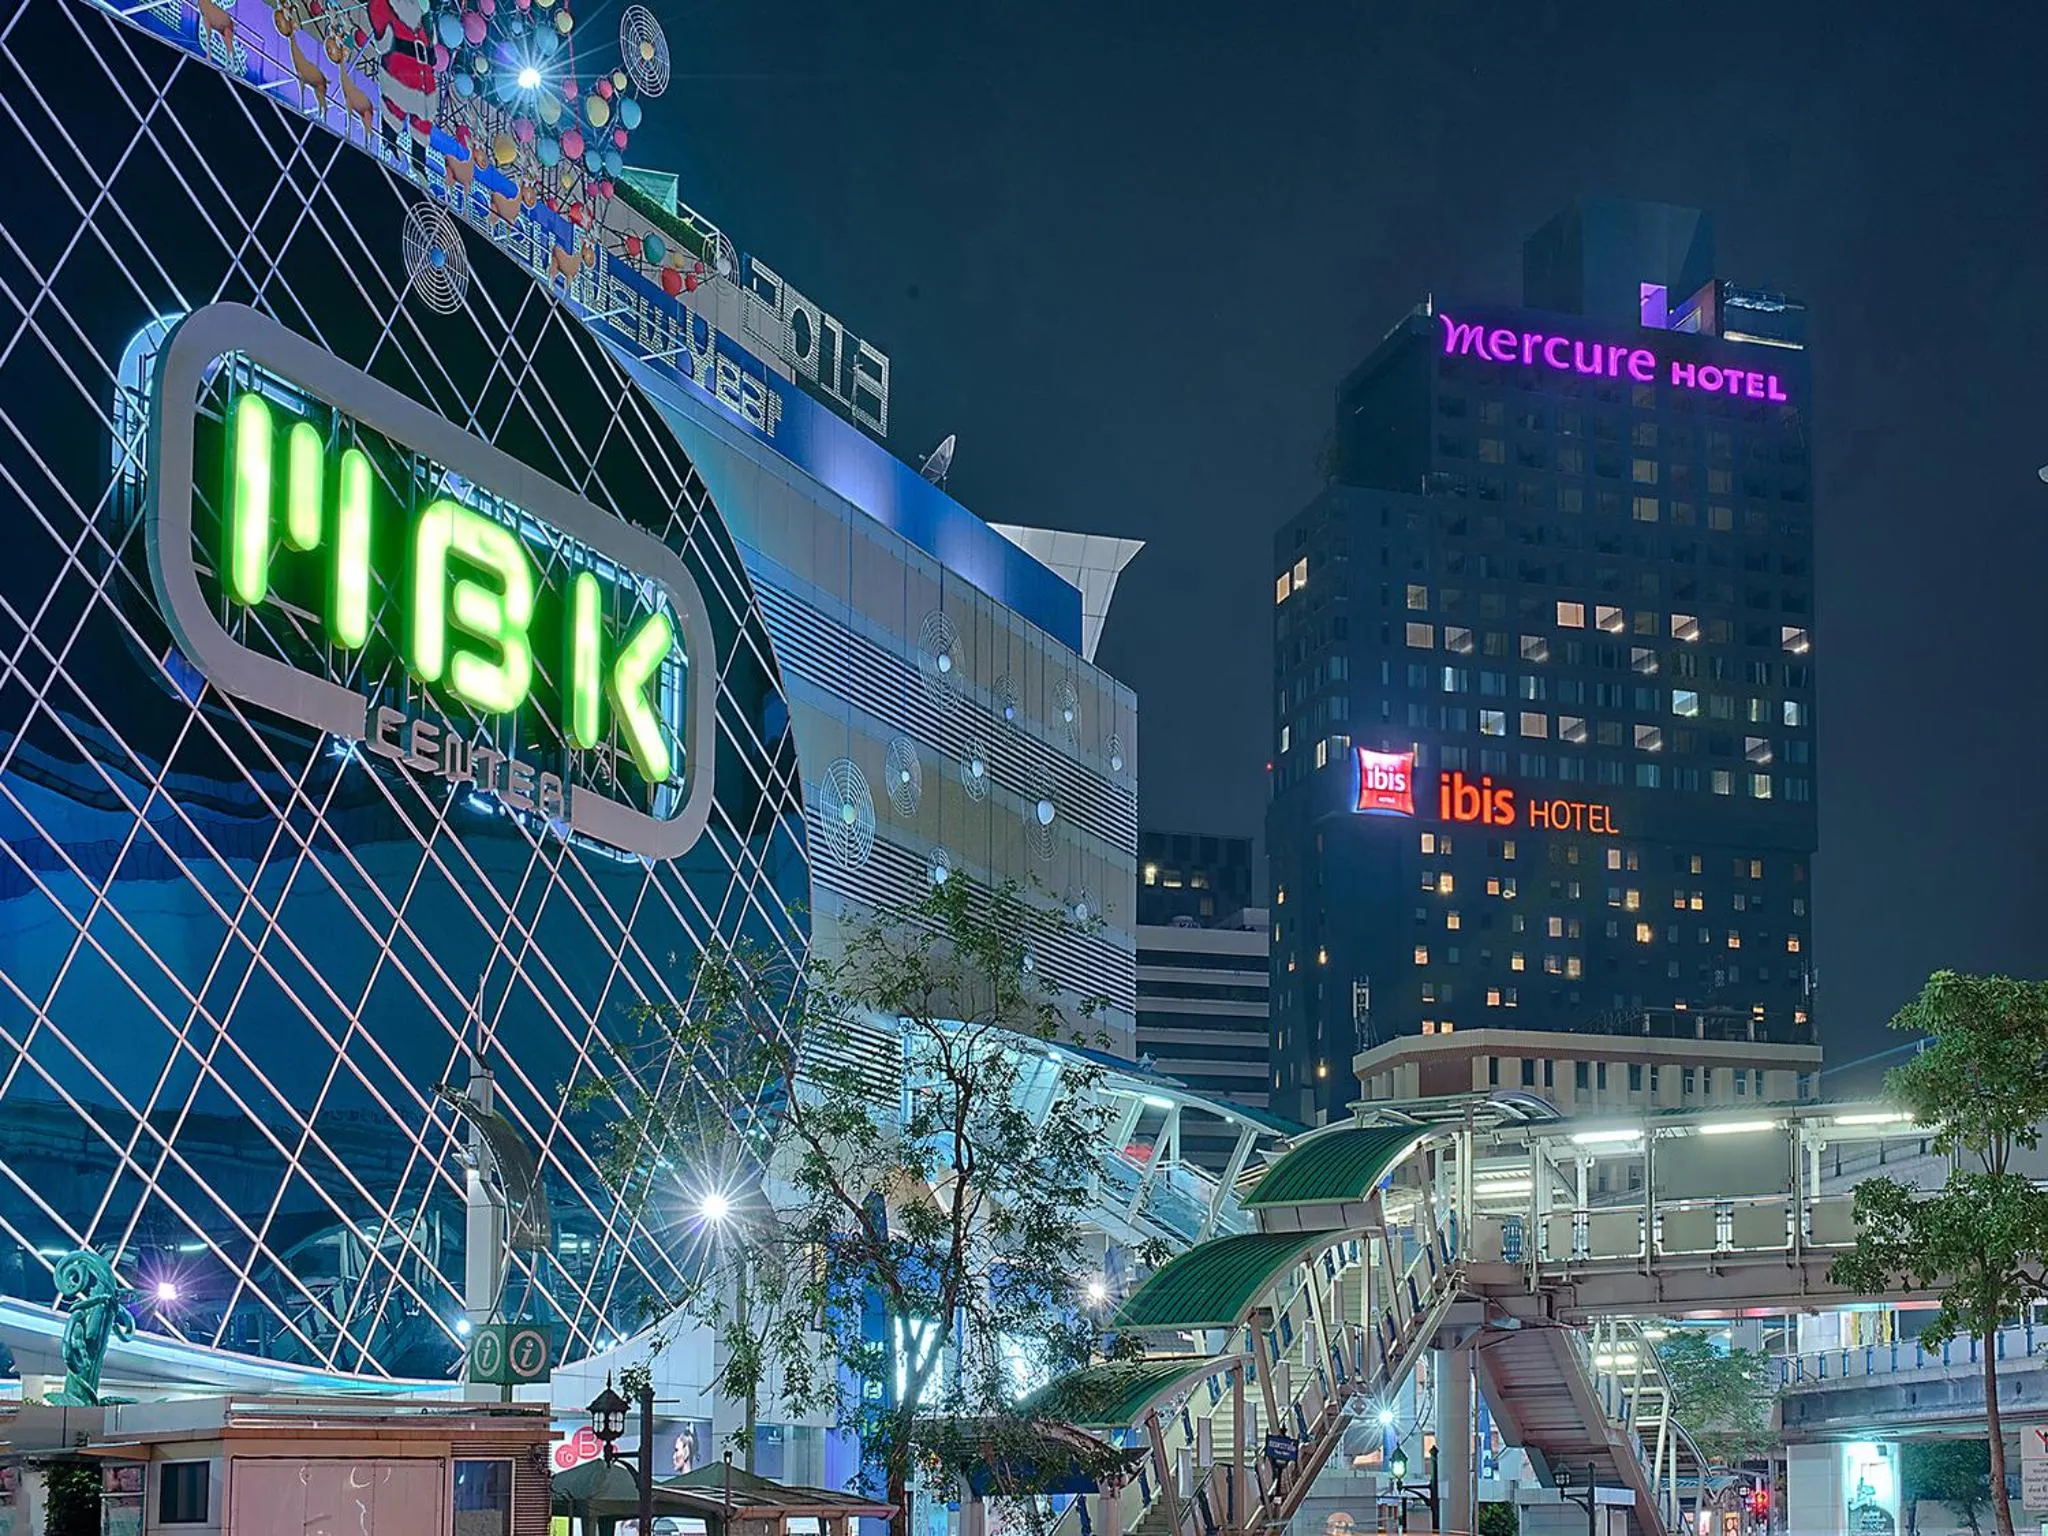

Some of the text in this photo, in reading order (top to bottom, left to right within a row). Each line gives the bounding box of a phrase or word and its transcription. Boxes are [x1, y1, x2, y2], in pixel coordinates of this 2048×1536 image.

[686, 306, 783, 438] Year
[1440, 314, 1787, 401] mercure HOTEL
[222, 392, 673, 784] MBK
[366, 705, 565, 819] CENTER
[1367, 766, 1406, 792] ibis
[1440, 772, 1619, 834] ibis HOTEL
